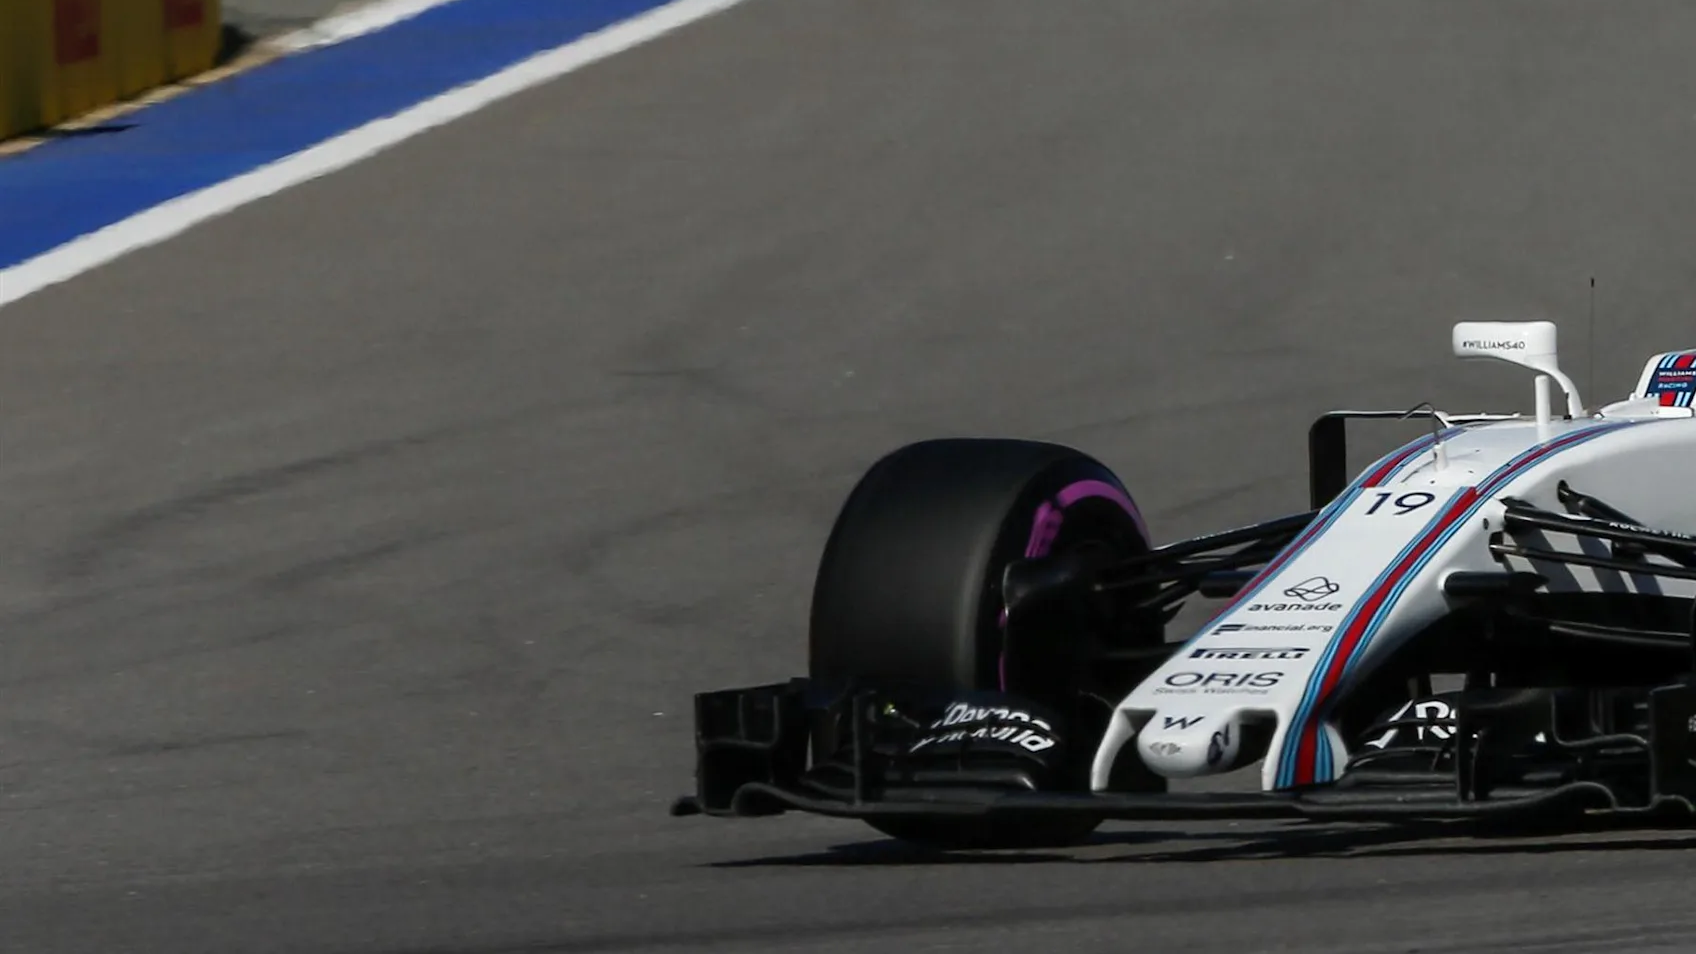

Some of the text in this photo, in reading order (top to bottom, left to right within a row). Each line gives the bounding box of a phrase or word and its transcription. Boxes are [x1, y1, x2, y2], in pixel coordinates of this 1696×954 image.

[1463, 340, 1526, 350] #WILLIAMS40
[1364, 491, 1436, 516] 19
[1248, 602, 1343, 612] avanade
[1188, 648, 1311, 660] PIRELLI
[1164, 671, 1285, 688] ORIS
